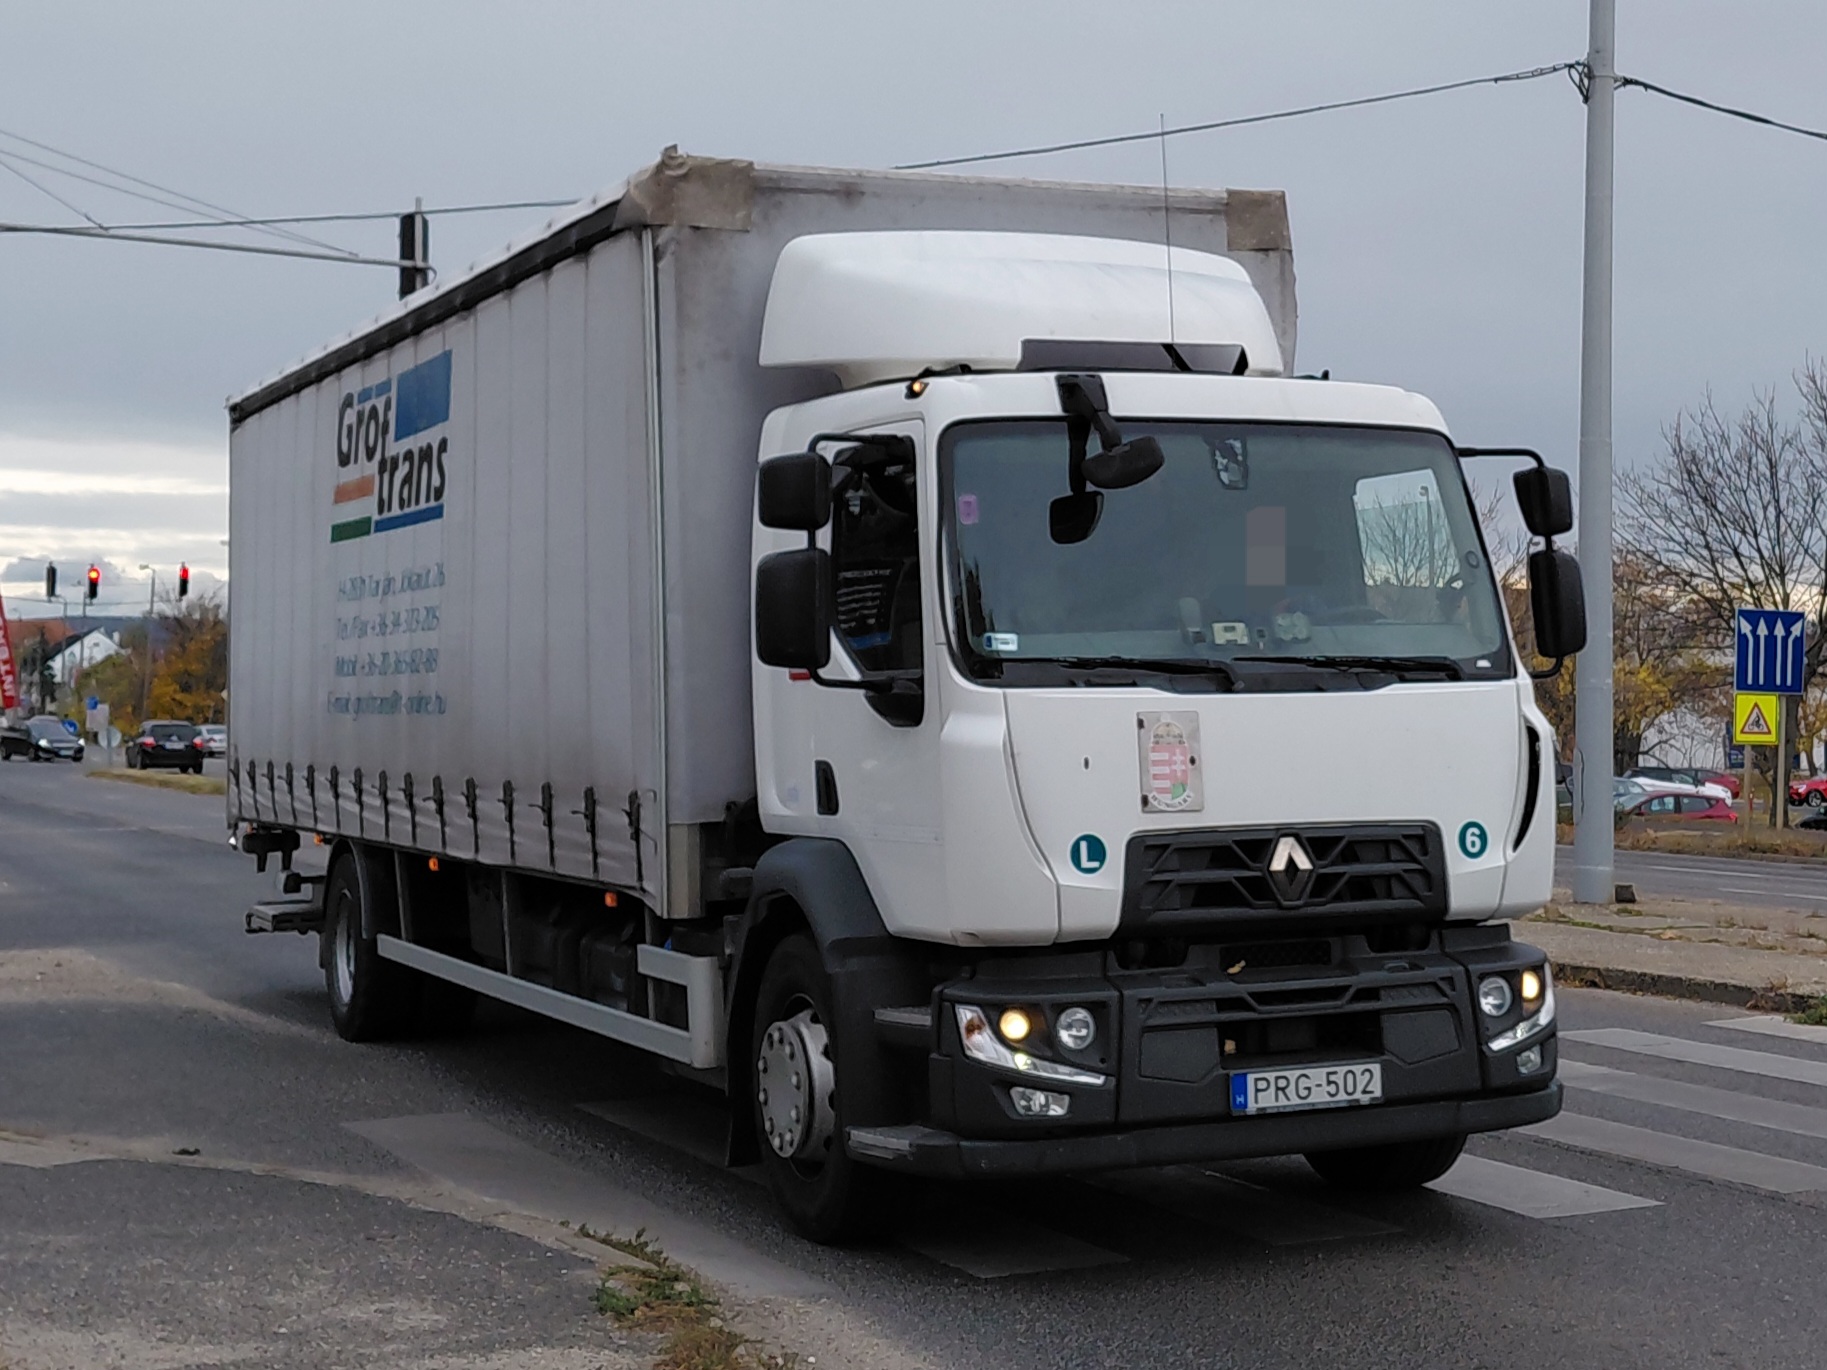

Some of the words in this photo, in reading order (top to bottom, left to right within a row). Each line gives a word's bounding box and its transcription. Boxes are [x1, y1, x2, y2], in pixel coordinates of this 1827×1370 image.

[337, 392, 391, 468] Grof
[377, 436, 448, 516] trans
[1080, 840, 1100, 868] L
[1465, 827, 1481, 853] 6
[1235, 1094, 1245, 1105] H
[1253, 1068, 1375, 1105] PRG-502
